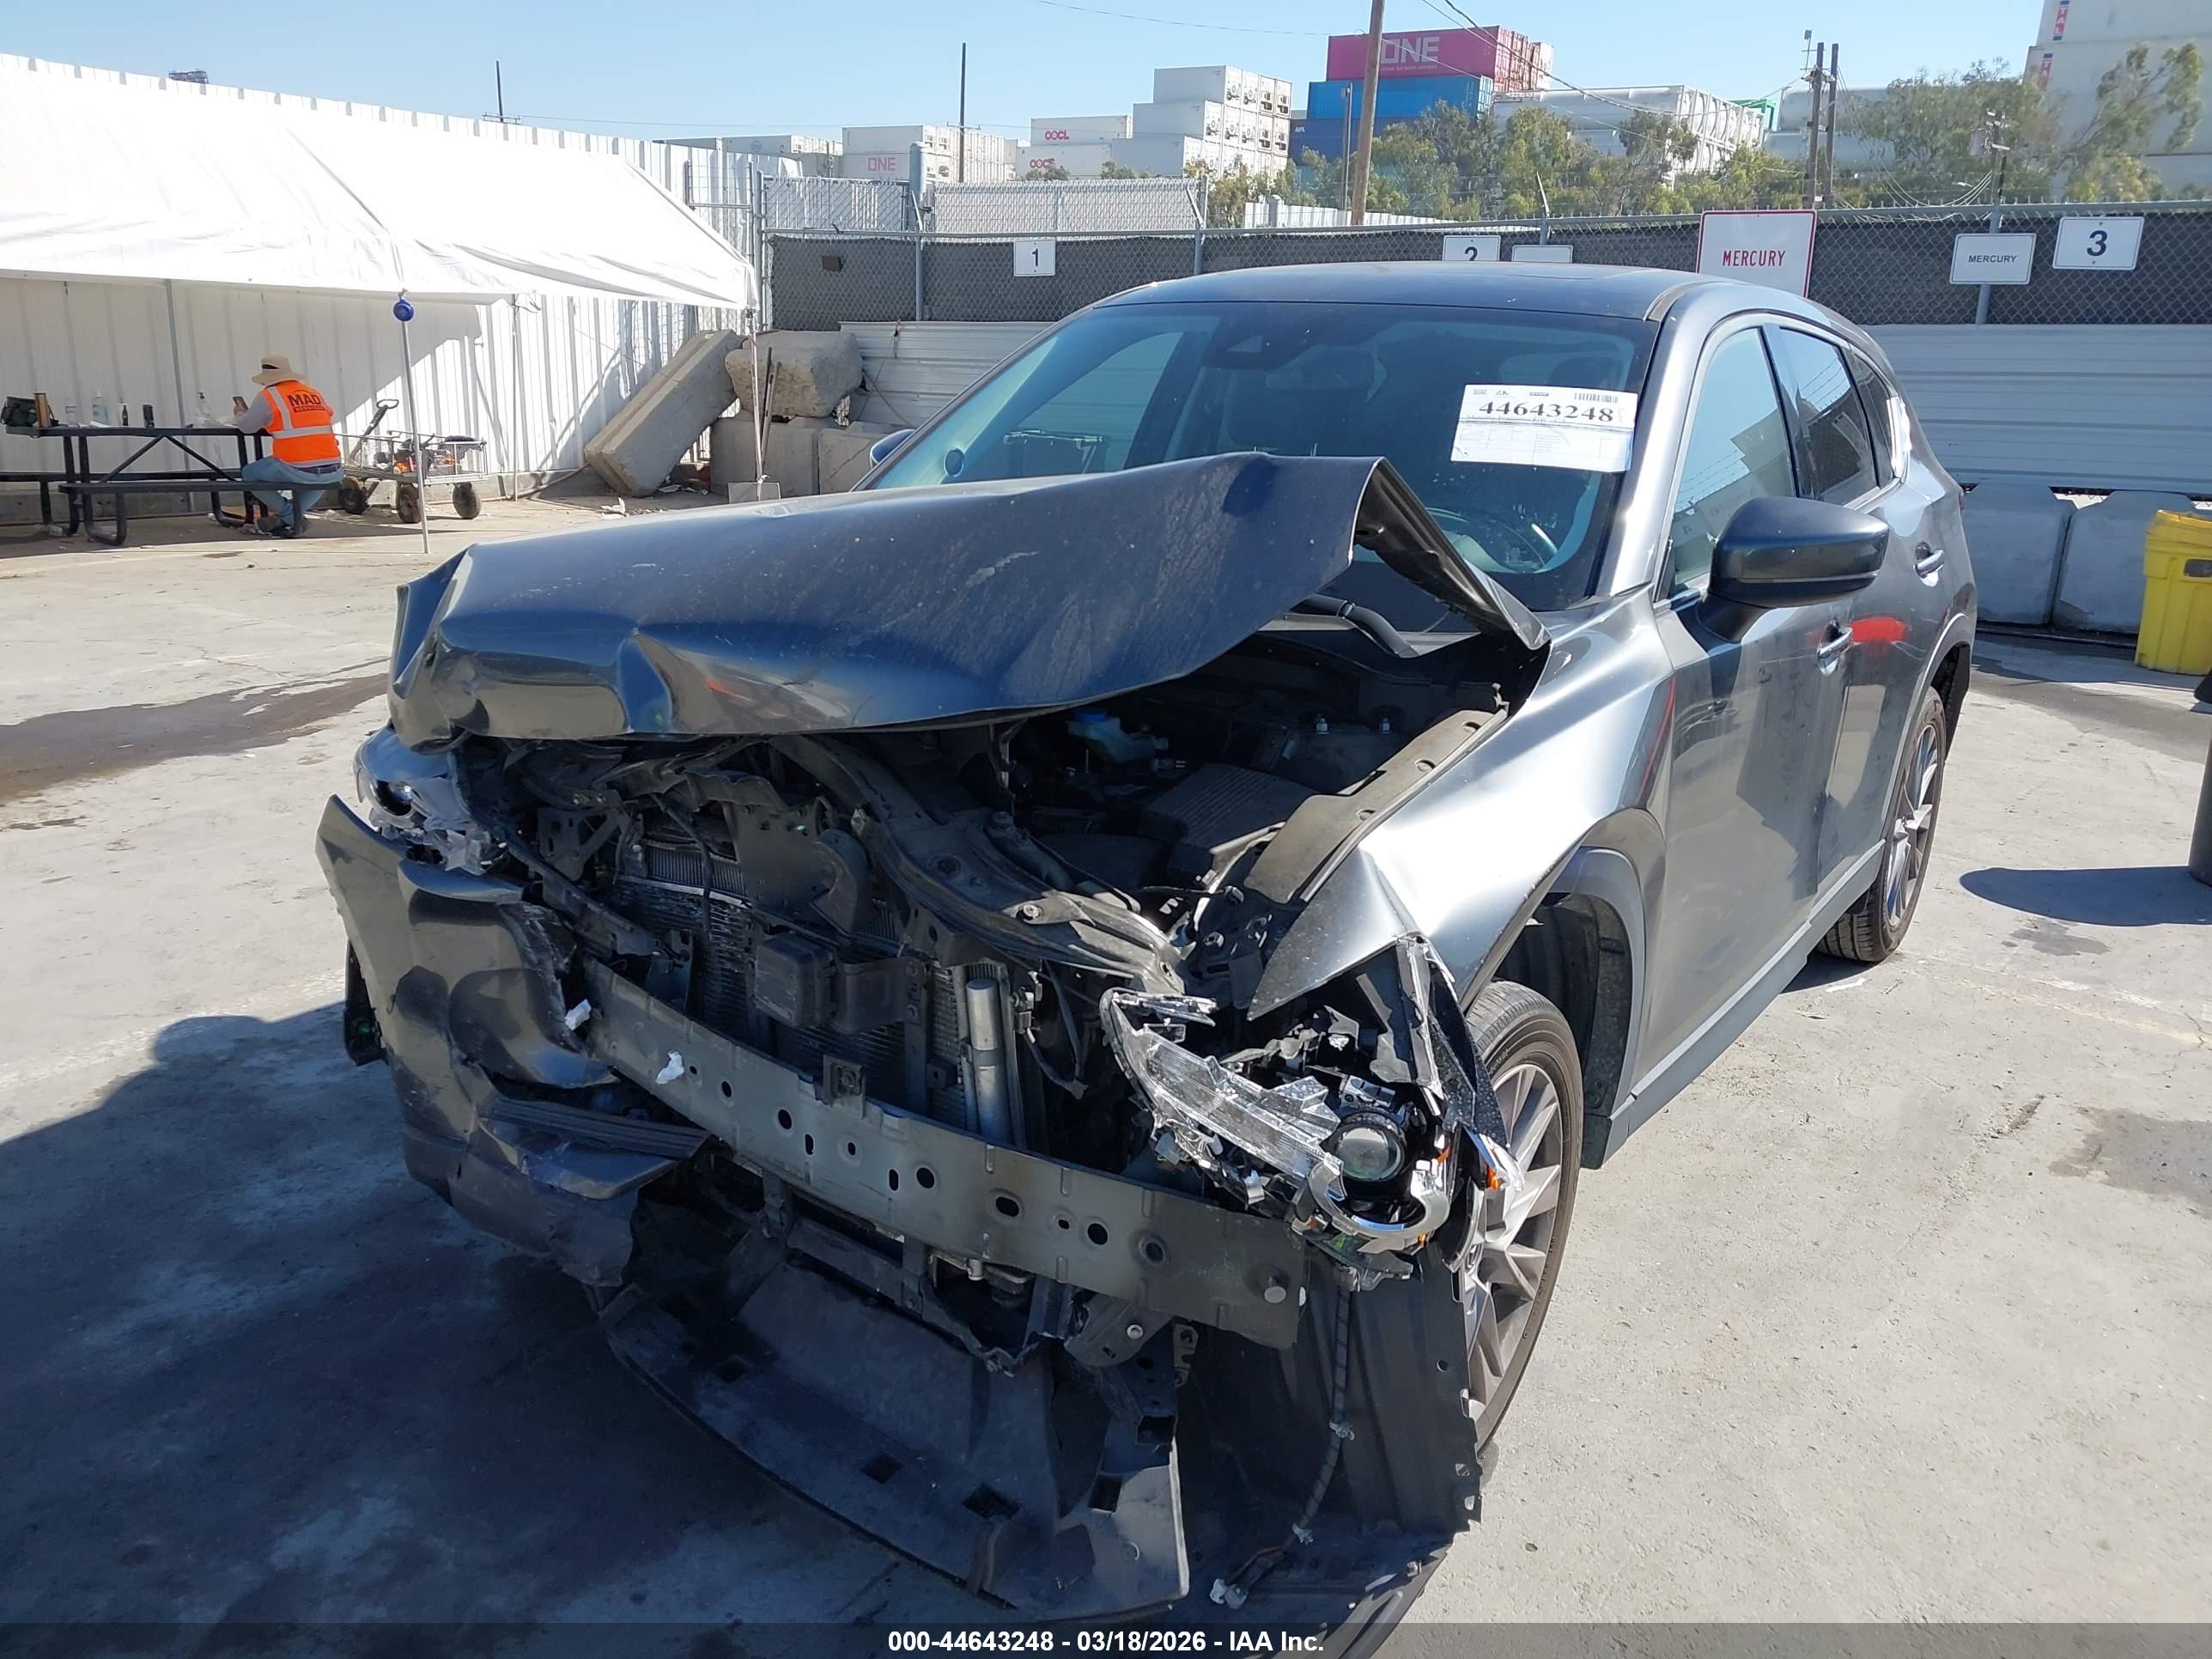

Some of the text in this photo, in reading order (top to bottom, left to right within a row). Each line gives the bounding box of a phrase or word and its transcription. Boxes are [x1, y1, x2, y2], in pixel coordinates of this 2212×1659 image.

[1379, 36, 1440, 64] ONE
[867, 157, 896, 172] ONE
[2087, 229, 2108, 257] 3
[1031, 247, 1039, 267] 1
[1723, 250, 1786, 267] MERCURY
[287, 394, 322, 406] MAD
[1479, 401, 1614, 422] 44643248
